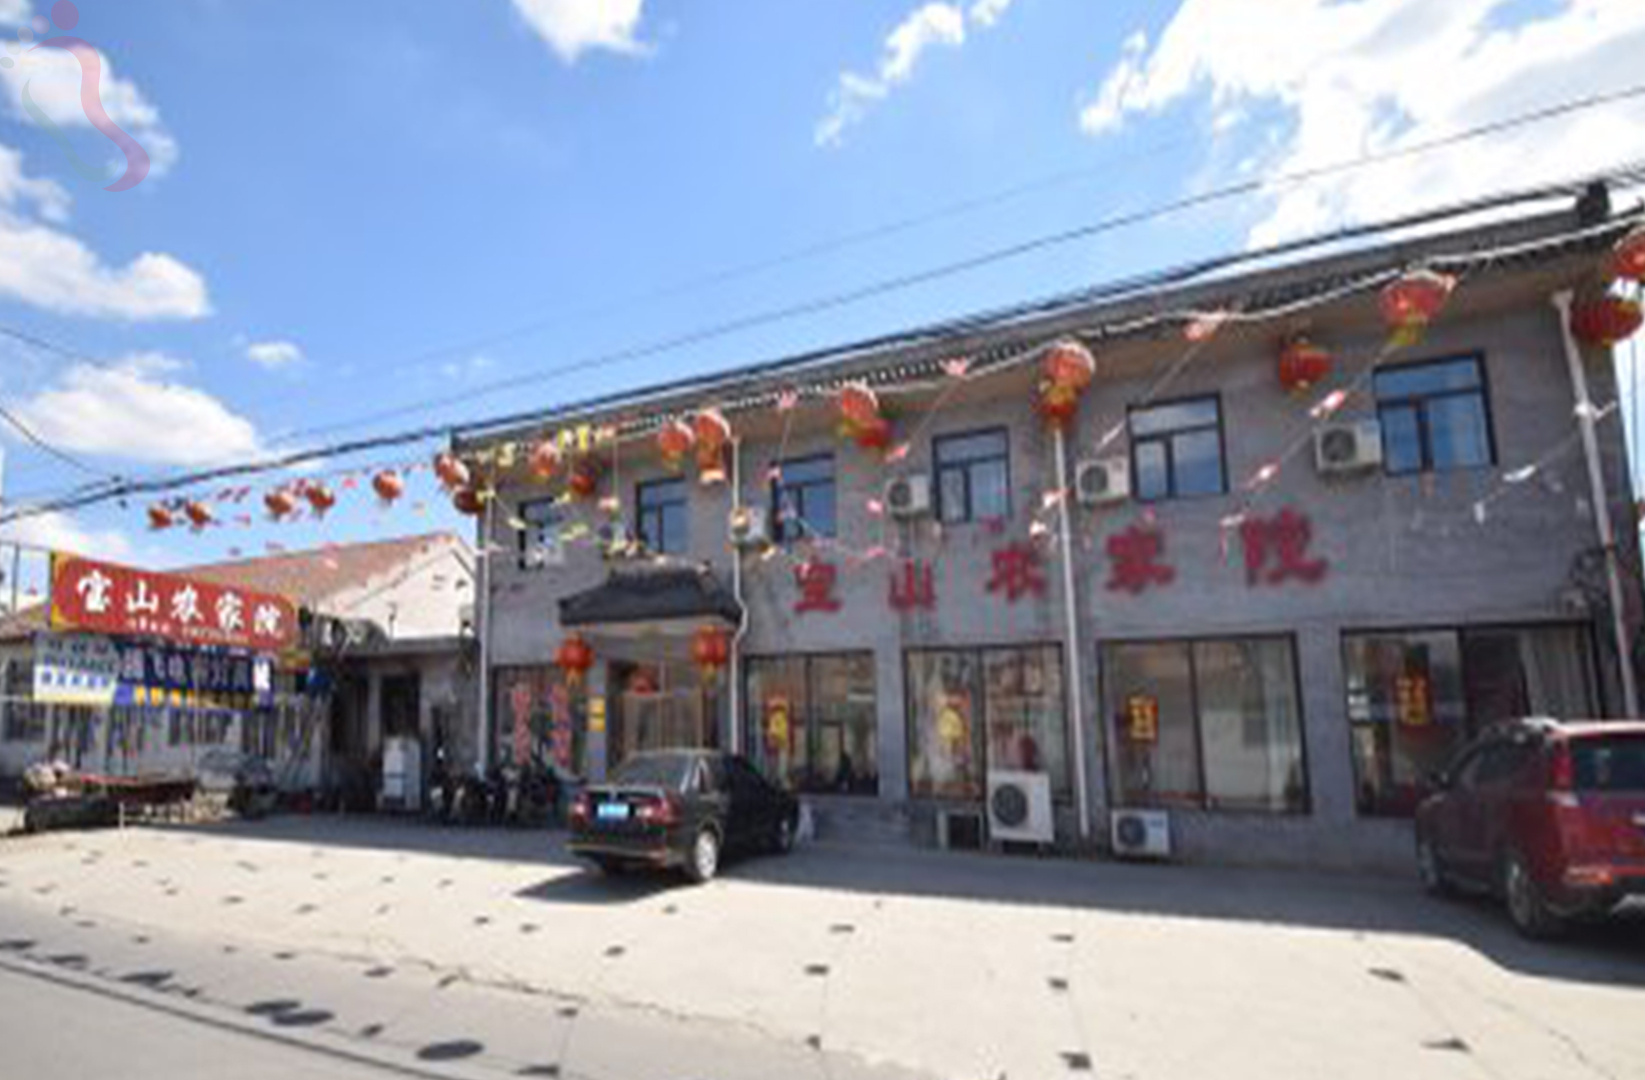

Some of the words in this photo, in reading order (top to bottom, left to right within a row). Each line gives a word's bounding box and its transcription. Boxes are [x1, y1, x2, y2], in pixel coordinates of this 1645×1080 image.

[77, 568, 283, 635] 宝山农家院
